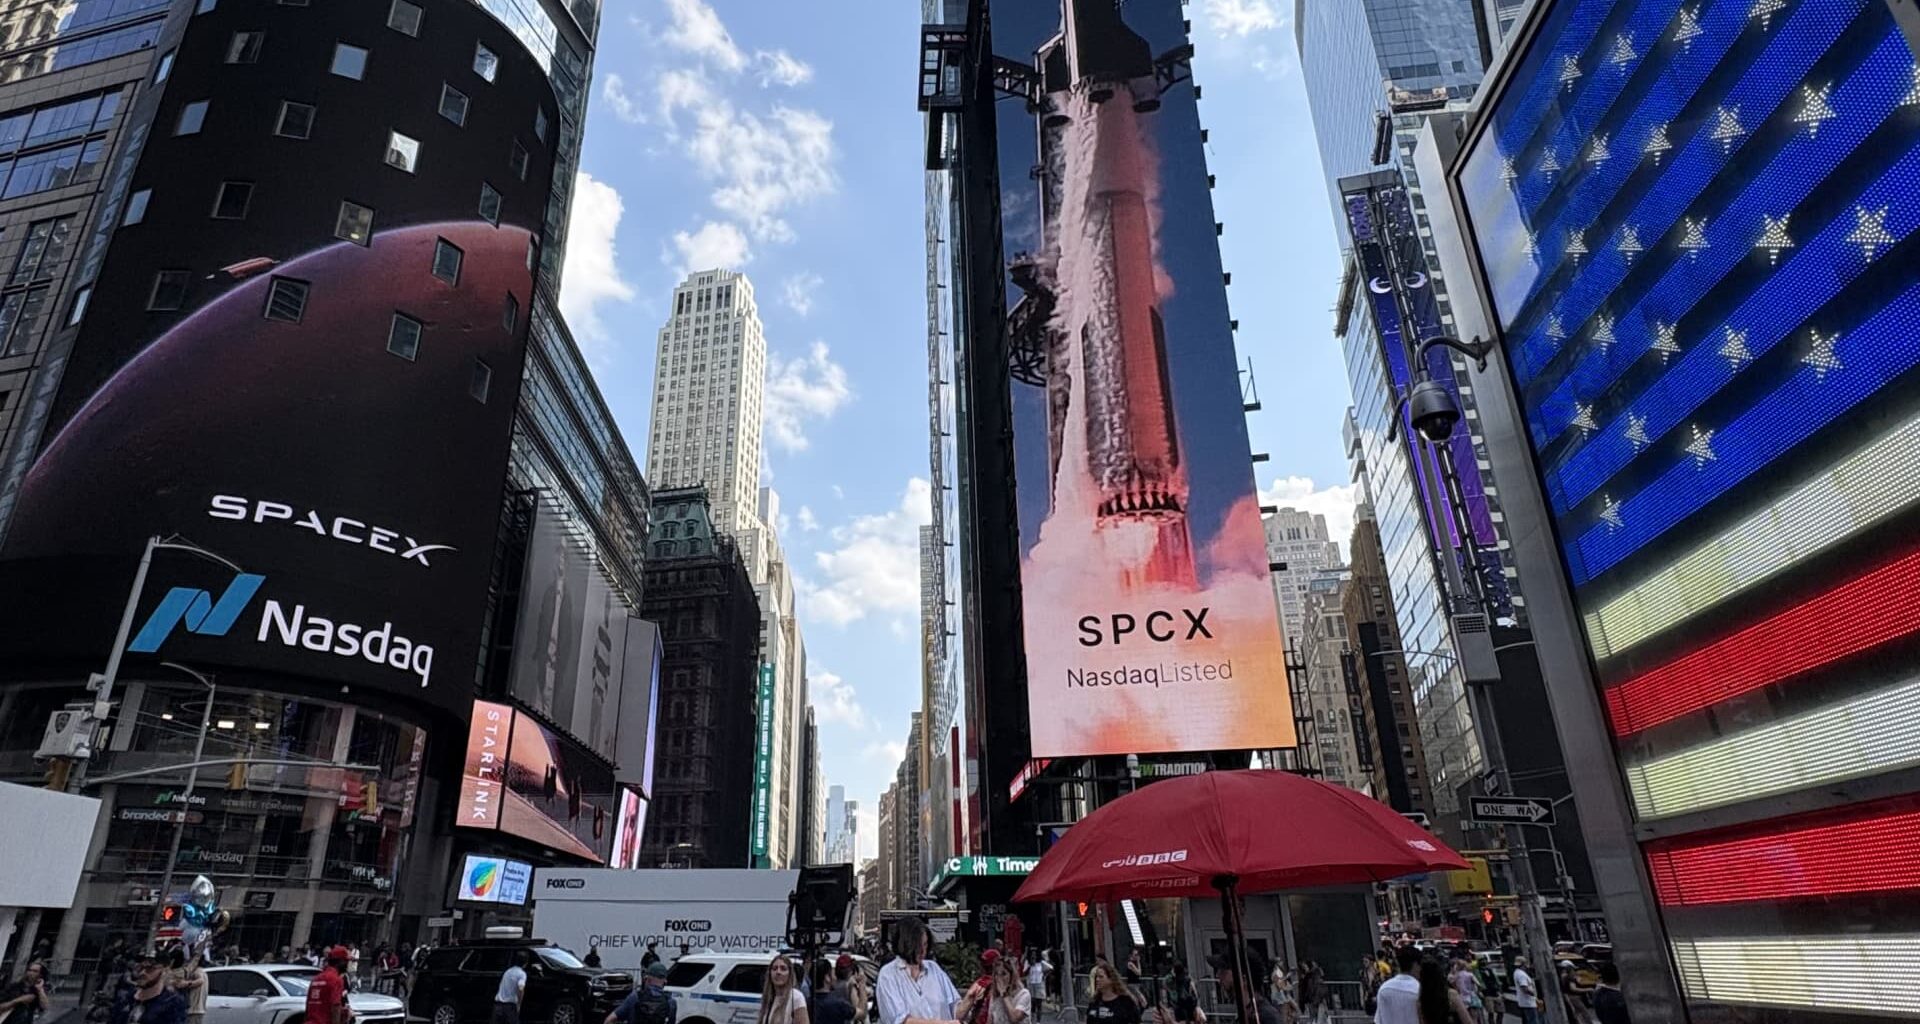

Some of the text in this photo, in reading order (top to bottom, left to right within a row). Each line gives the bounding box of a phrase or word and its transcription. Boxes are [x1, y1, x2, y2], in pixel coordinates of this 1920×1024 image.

[208, 494, 458, 567] SPACEX
[1078, 607, 1214, 647] SPCX
[256, 600, 434, 688] Nasdaq
[472, 709, 500, 820] STARLINK
[121, 810, 171, 821] branded
[1482, 804, 1541, 817] ONE WAY
[1136, 850, 1187, 866] BBC
[546, 879, 566, 889] FOX
[664, 920, 711, 932] FOX ONE
[588, 935, 629, 948] CHIEF
[632, 935, 684, 948] WORLD
[689, 935, 716, 948] CUP
